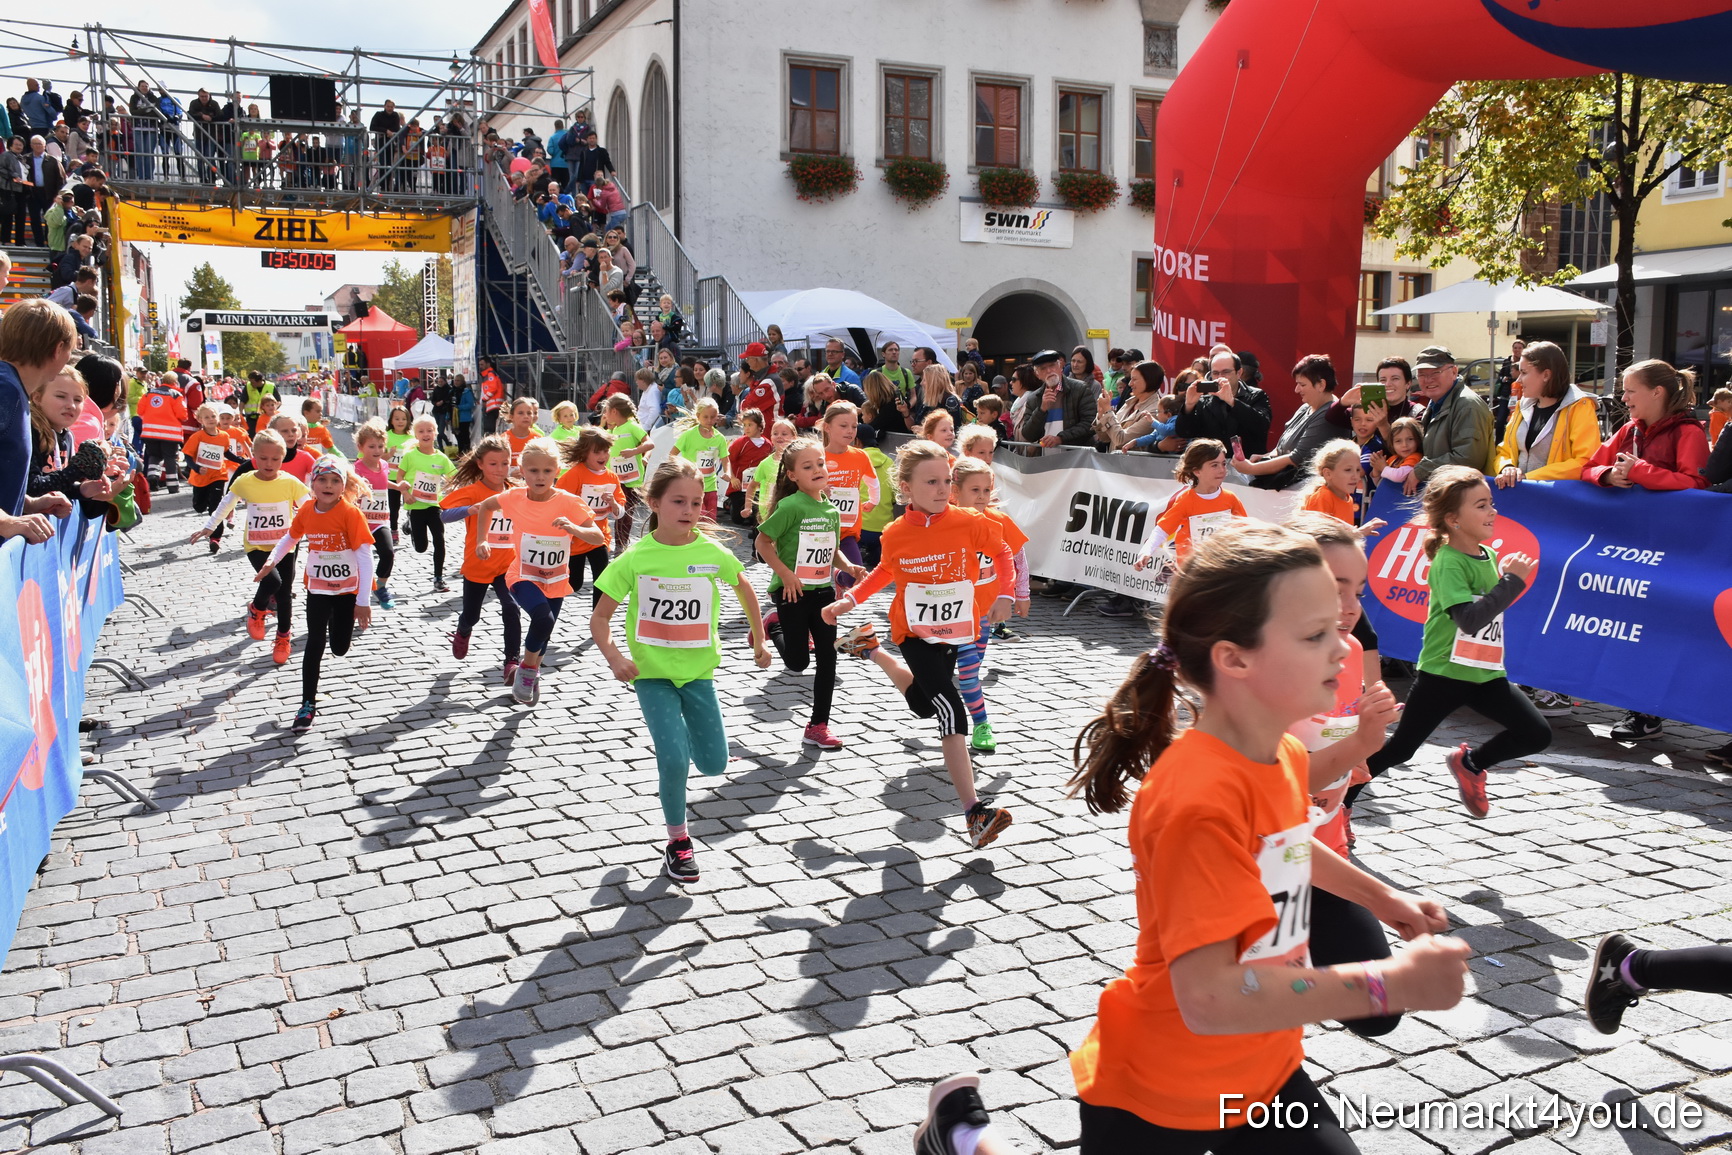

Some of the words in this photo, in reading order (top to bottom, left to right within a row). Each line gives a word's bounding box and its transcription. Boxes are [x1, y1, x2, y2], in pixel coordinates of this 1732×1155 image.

[137, 222, 179, 231] Neumarkter
[179, 225, 212, 233] Stadtlauf
[984, 212, 1030, 229] swn
[254, 217, 328, 242] ZIEL
[984, 227, 1014, 235] stadtwerke
[1015, 229, 1041, 237] neumarkt
[216, 314, 245, 325] MINI
[248, 315, 317, 326] NEUMARKT.
[1152, 305, 1226, 347] ONLINE
[202, 449, 221, 461] 7269
[613, 463, 634, 474] 7109
[418, 481, 436, 493] 7036
[252, 514, 285, 529] 7245
[491, 518, 513, 531] 717
[1065, 491, 1149, 545] swn
[528, 549, 565, 566] 7100
[806, 548, 833, 564] 7085
[899, 553, 946, 565] Neumarkter
[1597, 545, 1665, 566] STORE
[313, 564, 351, 578] 7068
[1084, 565, 1099, 578] wir
[1578, 572, 1651, 599] ONLINE
[649, 597, 701, 620] 7230
[915, 600, 964, 621] 7187
[1564, 613, 1643, 643] MOBILE
